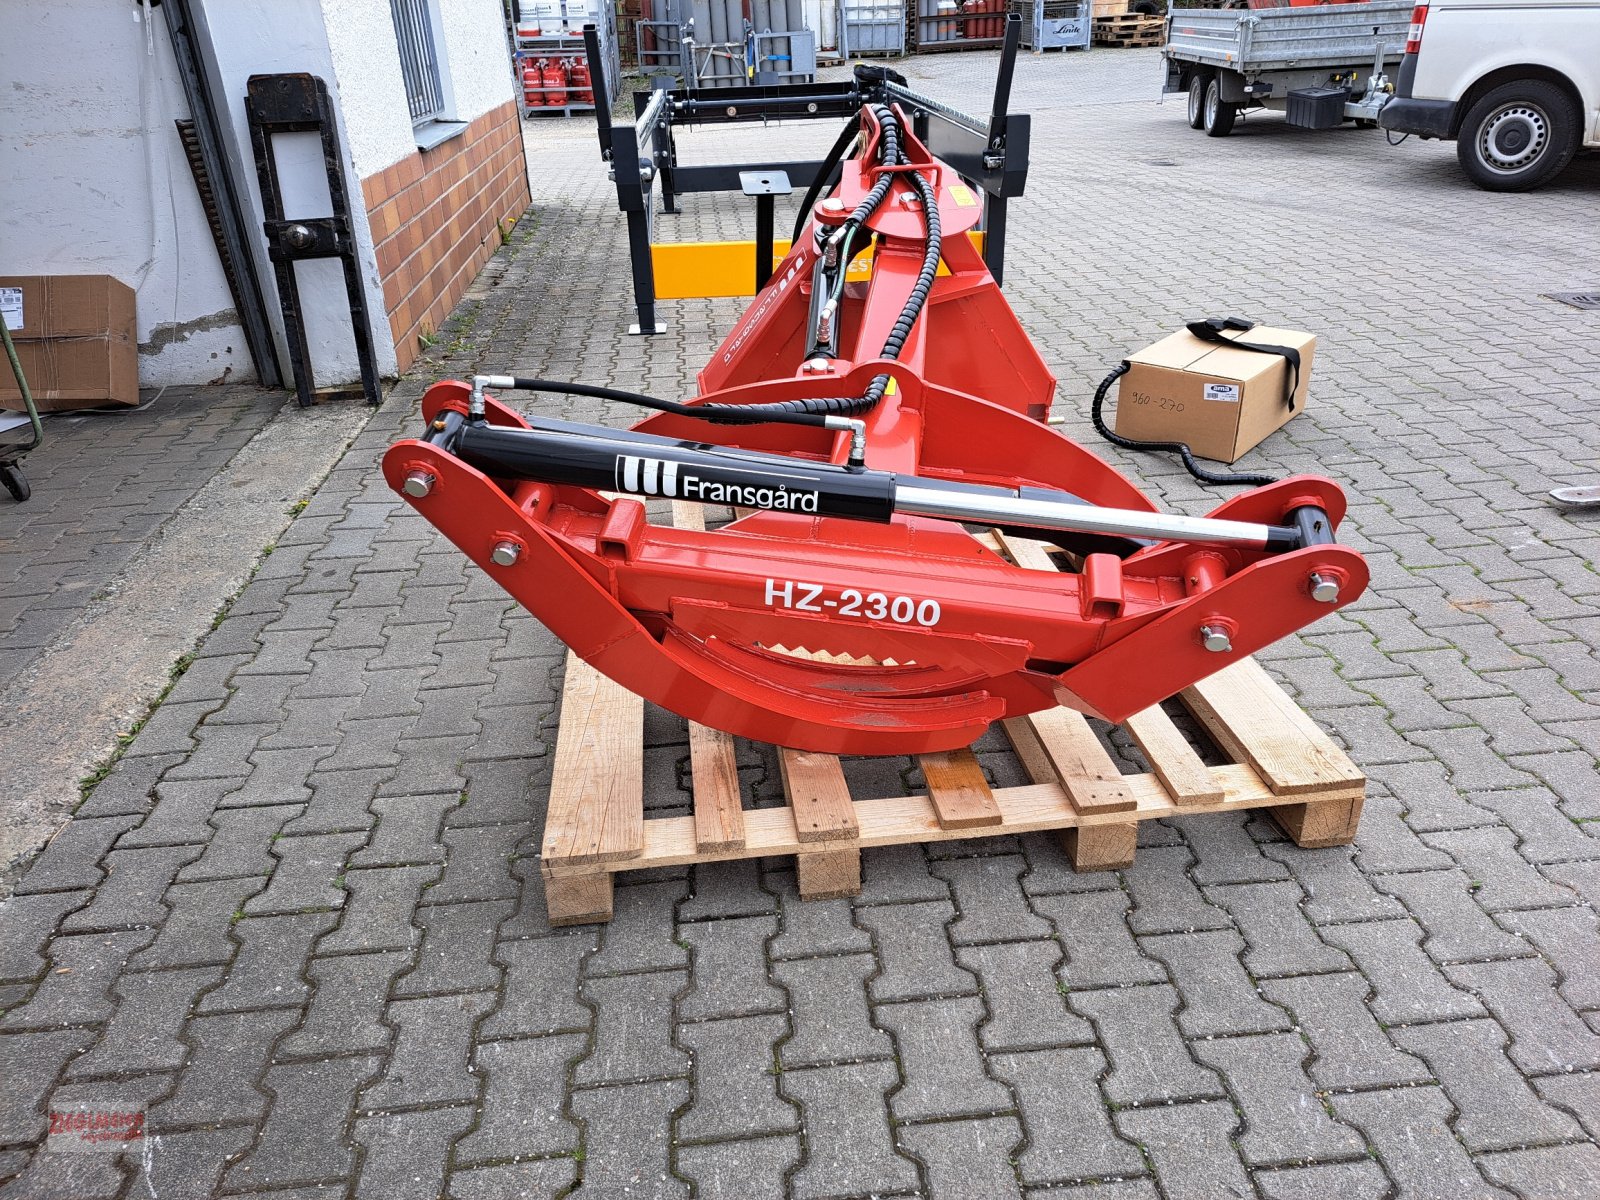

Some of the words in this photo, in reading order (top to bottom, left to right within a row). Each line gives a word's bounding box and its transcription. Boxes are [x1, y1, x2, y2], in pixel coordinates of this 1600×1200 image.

[1053, 24, 1080, 34] Linde
[683, 475, 819, 512] Fransgård
[764, 578, 941, 626] HZ-2300
